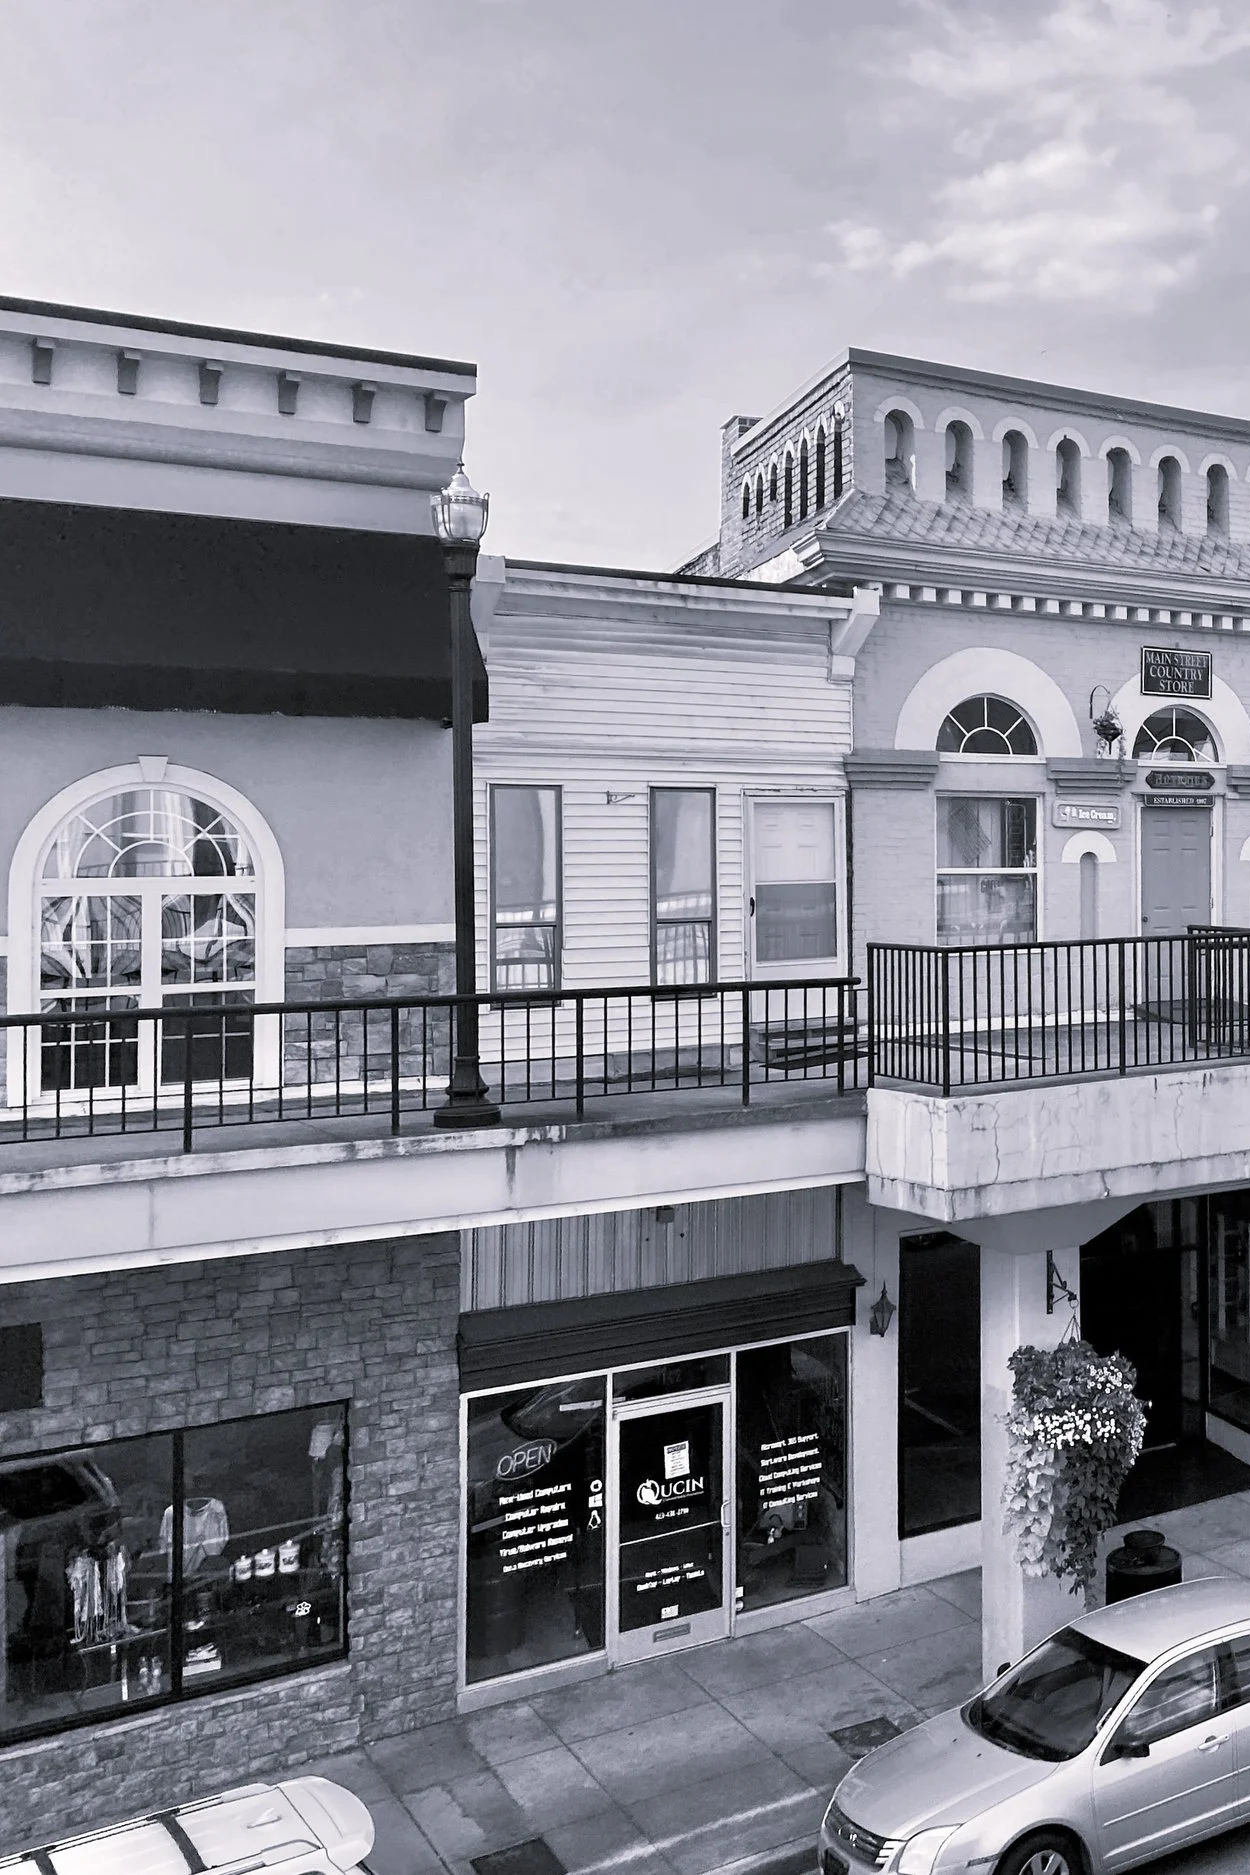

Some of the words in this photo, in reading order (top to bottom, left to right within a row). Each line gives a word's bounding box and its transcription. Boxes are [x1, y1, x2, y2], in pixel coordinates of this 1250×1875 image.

[1145, 652, 1171, 664] MAIN
[1174, 654, 1208, 668] STREET
[1149, 665, 1204, 680] COUNTRY
[1160, 680, 1194, 693] STORE
[497, 1444, 552, 1477] OPEN
[637, 1477, 704, 1505] QUCIN
